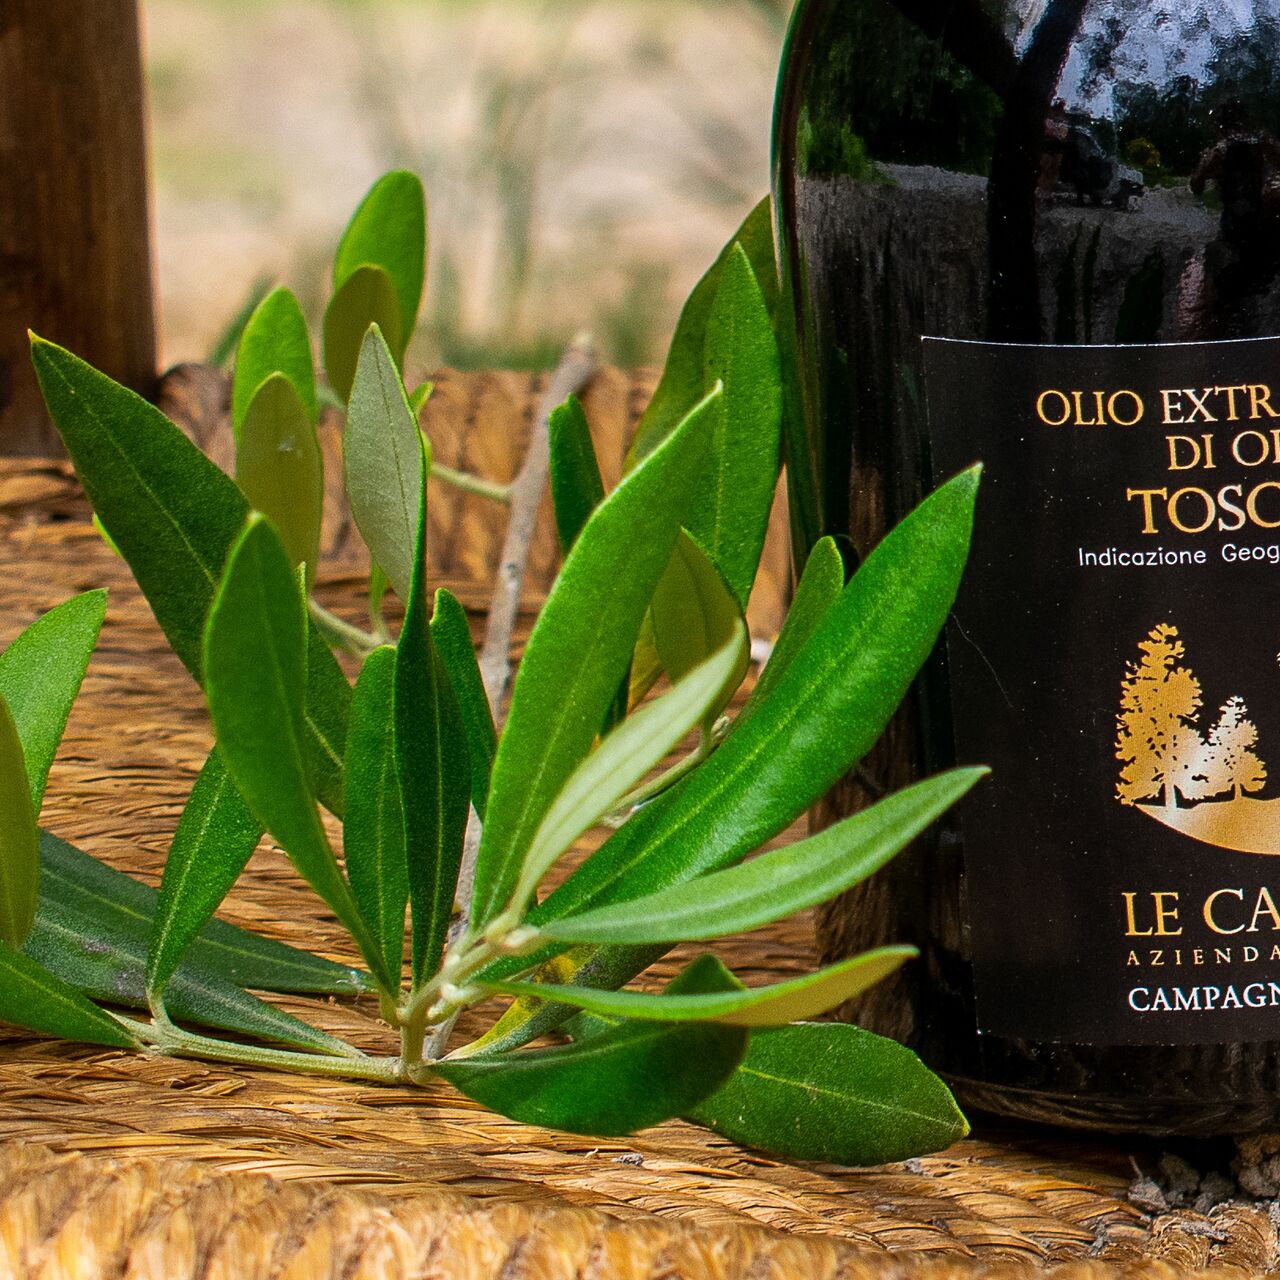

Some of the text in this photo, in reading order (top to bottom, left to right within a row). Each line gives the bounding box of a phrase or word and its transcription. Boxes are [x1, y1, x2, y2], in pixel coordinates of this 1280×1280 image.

[1037, 389, 1144, 426] OLIO
[1167, 435, 1213, 471] DI
[1078, 546, 1207, 567] Indicazione
[1122, 891, 1182, 937] LE
